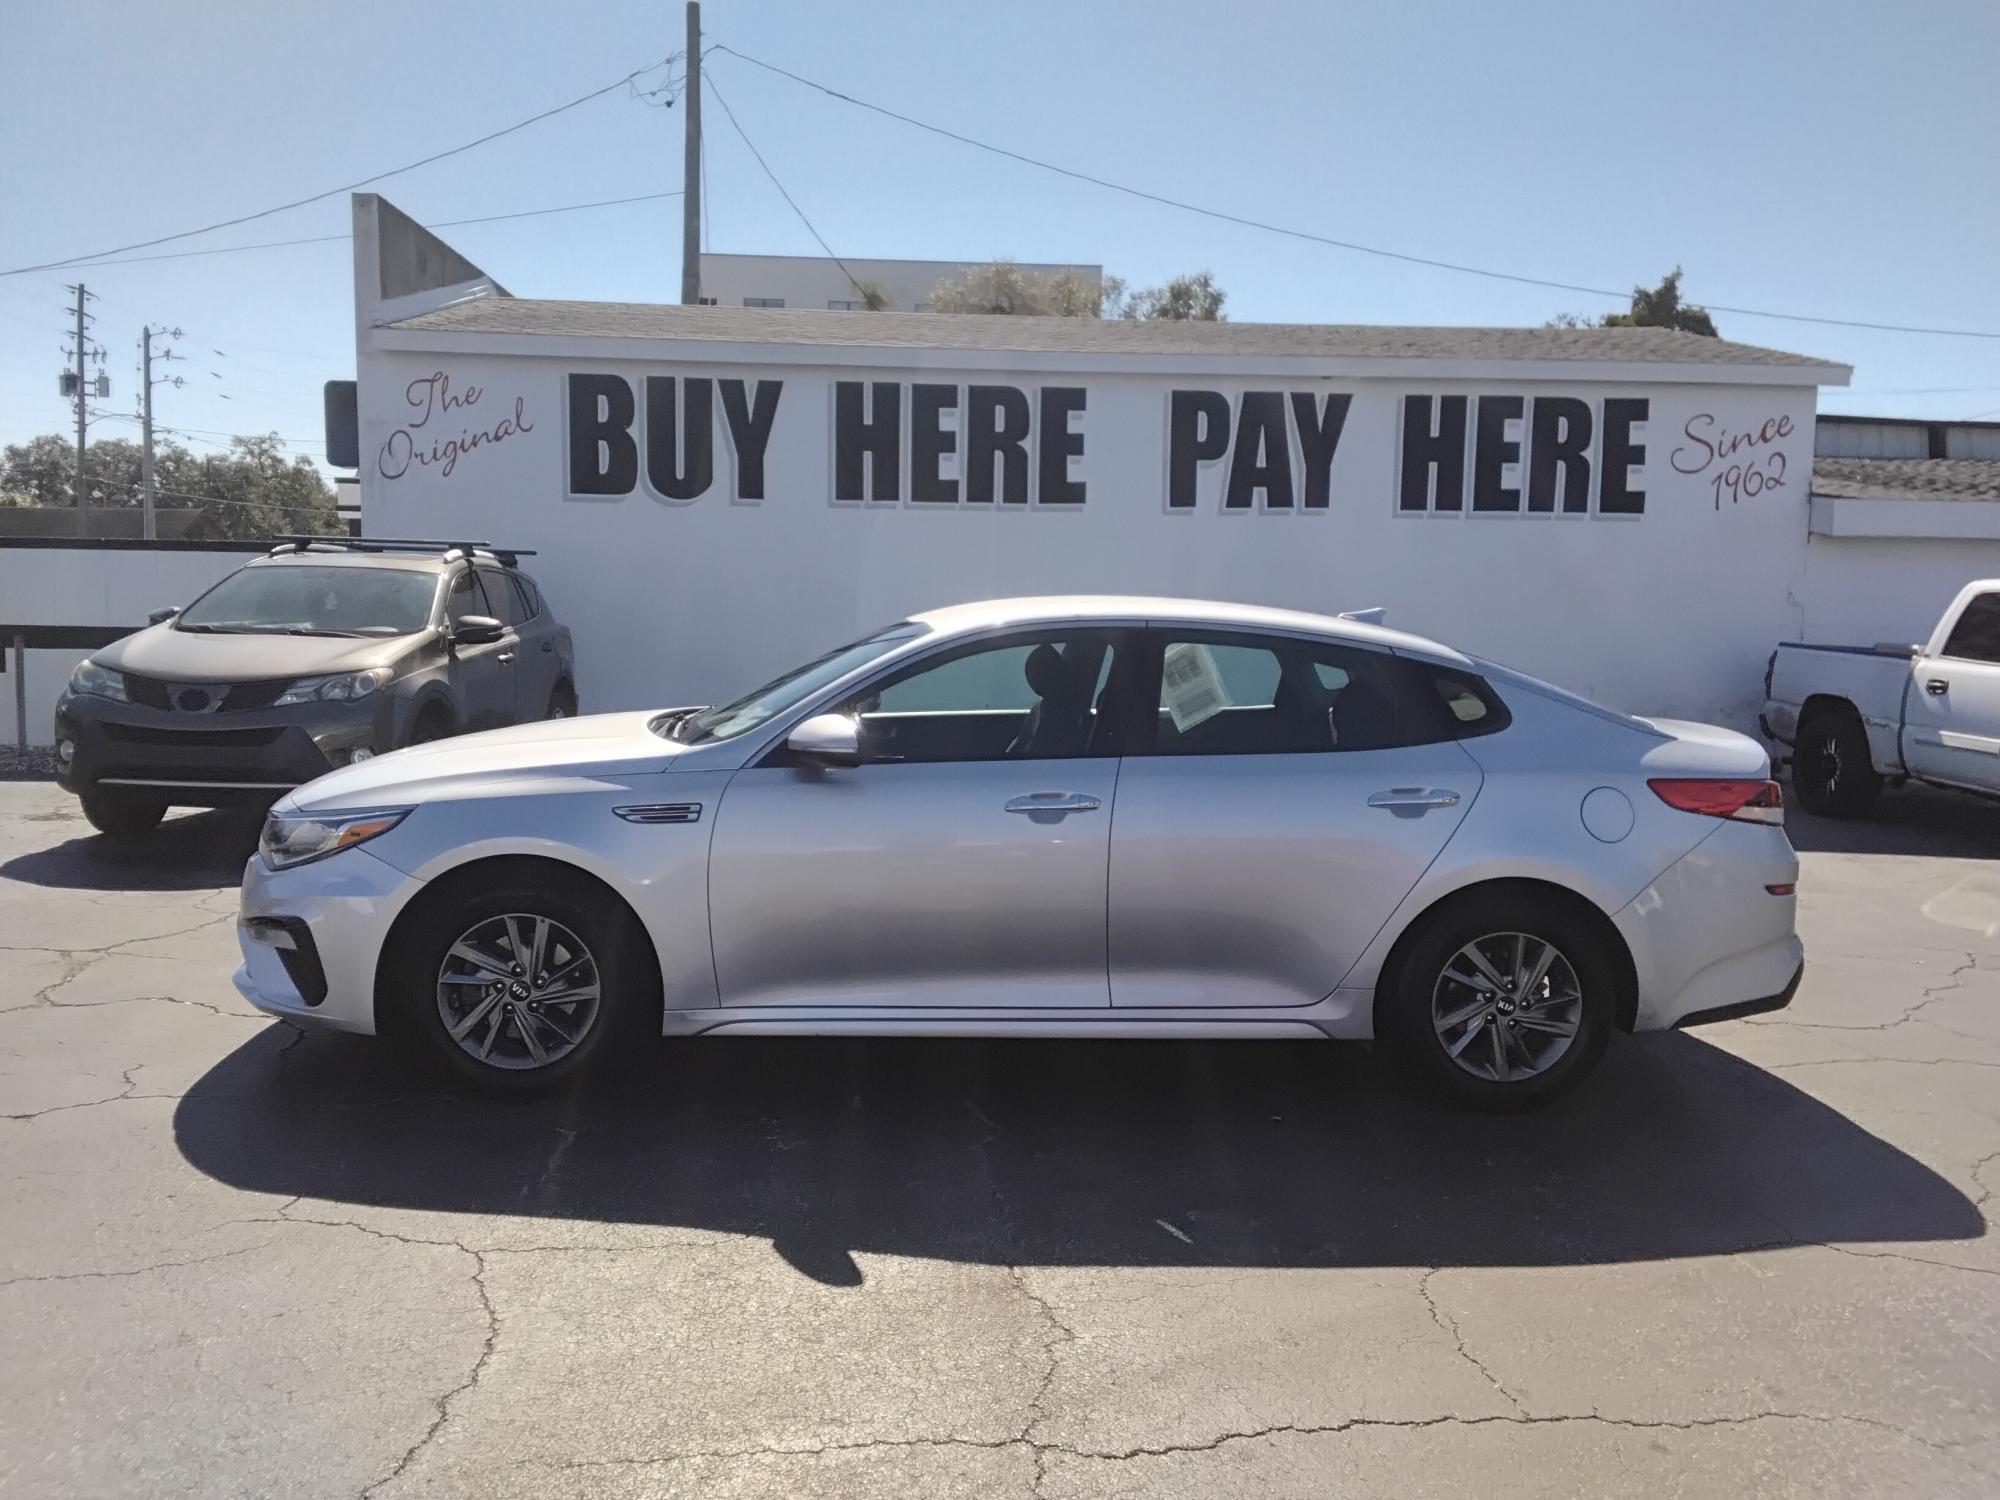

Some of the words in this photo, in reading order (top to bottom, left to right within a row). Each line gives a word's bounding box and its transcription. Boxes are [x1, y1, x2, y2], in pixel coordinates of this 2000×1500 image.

[406, 371, 484, 428] The
[378, 397, 534, 480] Original
[565, 373, 784, 504] BUY
[829, 381, 1087, 511] HERE
[1166, 389, 1353, 515] PAY
[1396, 394, 1650, 520] HERE
[1671, 412, 1795, 474] Since
[1711, 451, 1787, 511] 1962
[512, 983, 528, 998] KIA
[1497, 1000, 1514, 1012] KIA
